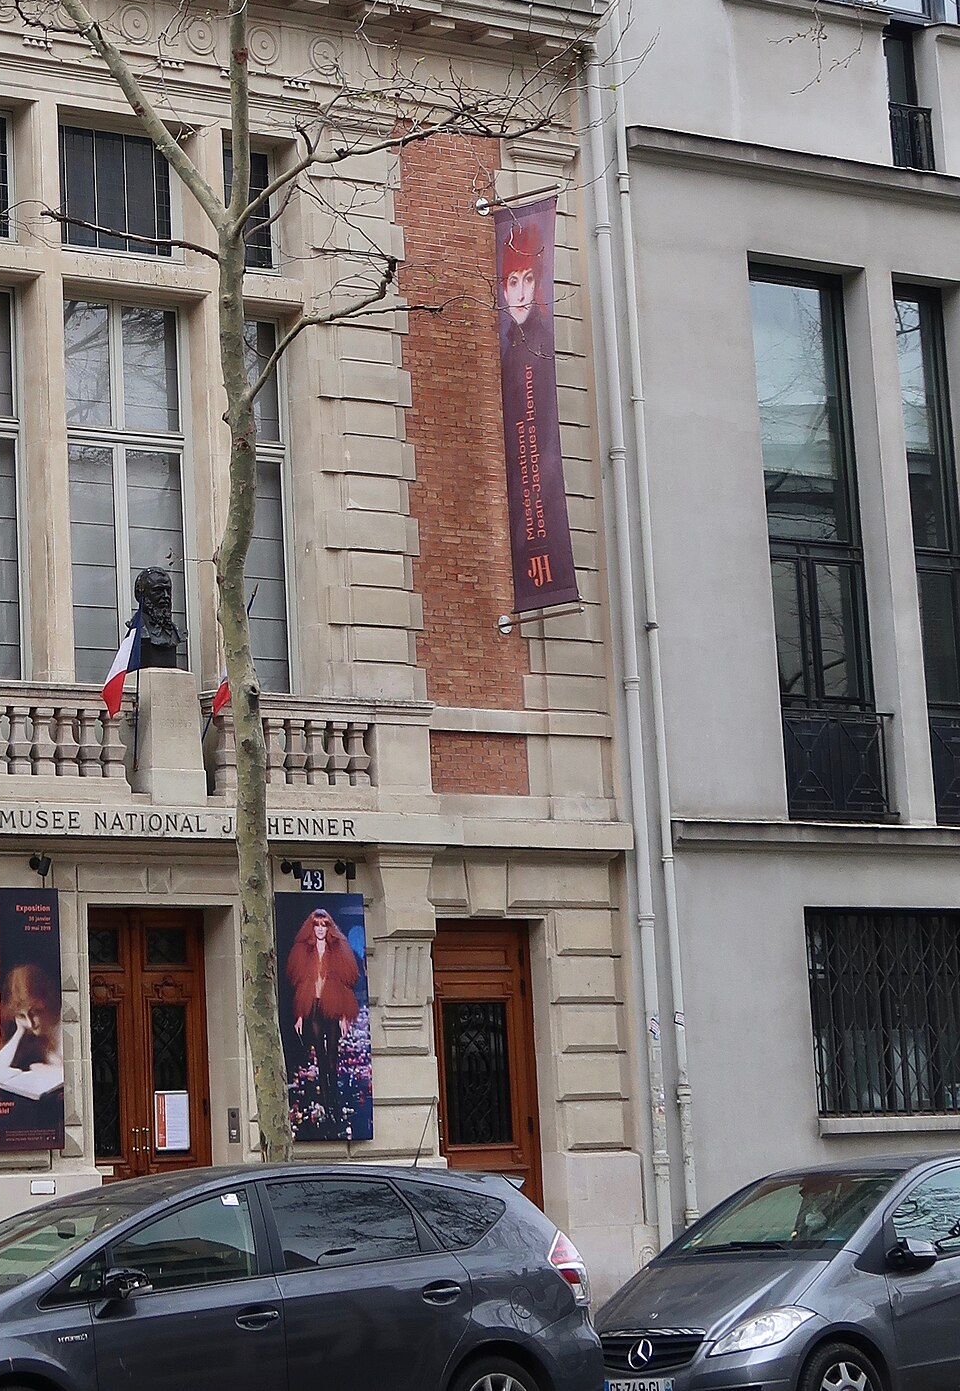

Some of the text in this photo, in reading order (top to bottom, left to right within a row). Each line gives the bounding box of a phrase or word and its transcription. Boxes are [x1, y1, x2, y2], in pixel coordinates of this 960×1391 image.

[525, 364, 547, 538] Jean-Jacques Henner
[516, 420, 536, 541] Musée national
[0, 810, 81, 829] MUSEE
[94, 811, 208, 833] NATIONAL
[267, 817, 356, 837] HENNER
[302, 870, 323, 890] 43
[16, 904, 50, 913] Exposition
